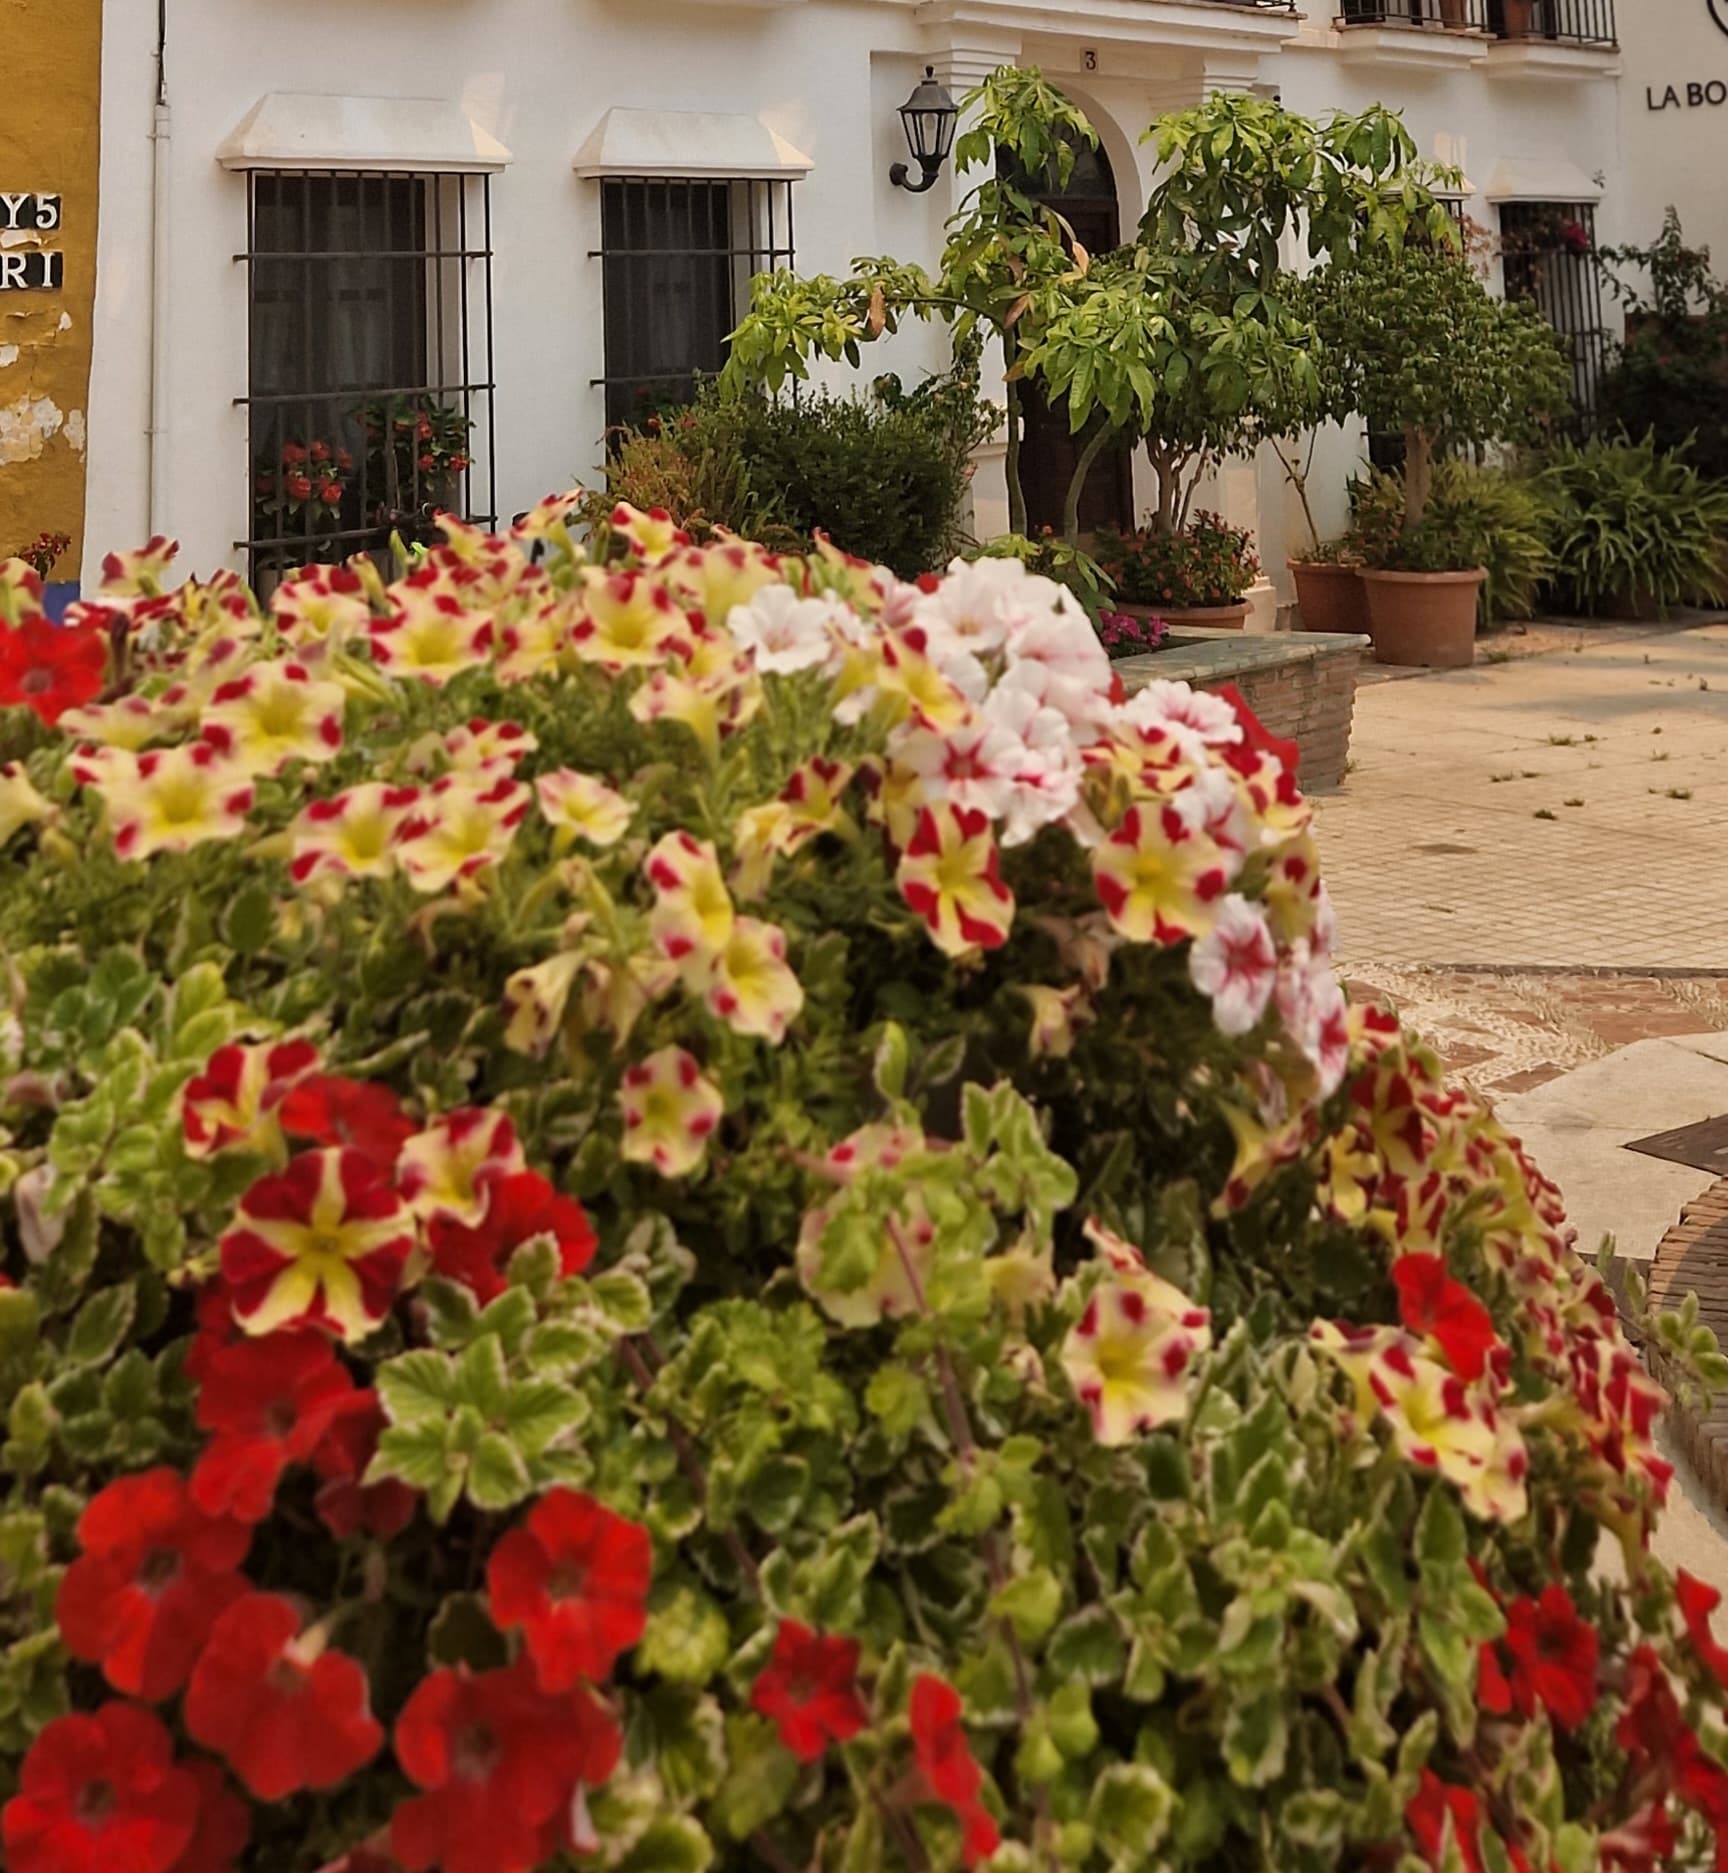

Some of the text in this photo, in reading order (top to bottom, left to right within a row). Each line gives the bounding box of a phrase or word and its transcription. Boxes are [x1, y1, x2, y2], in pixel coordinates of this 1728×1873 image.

[1085, 51, 1096, 70] 3
[1647, 85, 1681, 110] LA
[0, 252, 55, 289] RI
